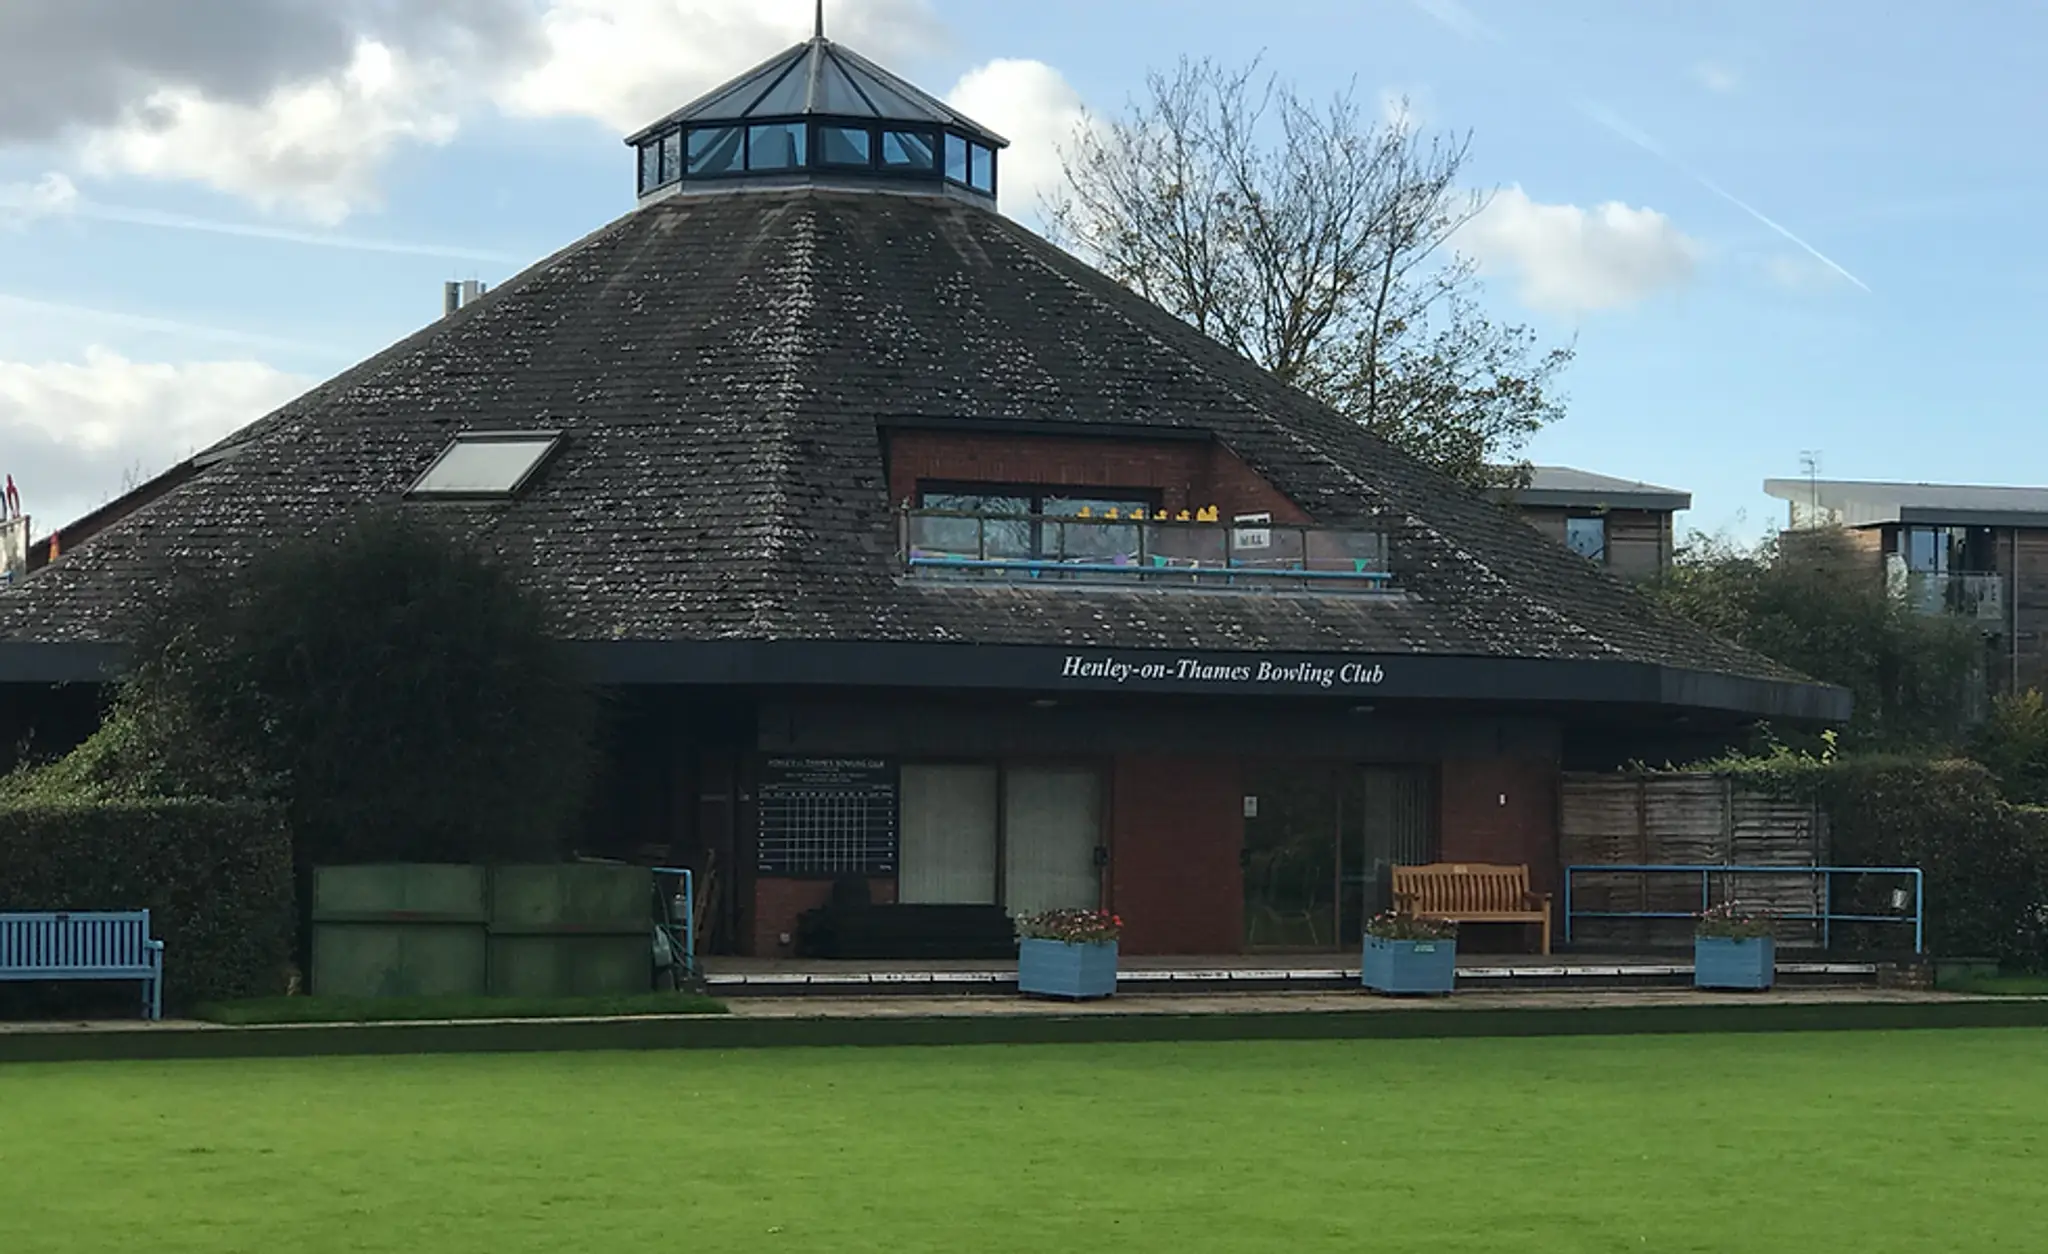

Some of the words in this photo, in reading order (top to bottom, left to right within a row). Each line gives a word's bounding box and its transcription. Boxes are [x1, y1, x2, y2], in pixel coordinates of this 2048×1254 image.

[1062, 656, 1250, 682] Henley-on-Thames
[1256, 661, 1334, 686] Bowling
[1339, 662, 1384, 683] Club
